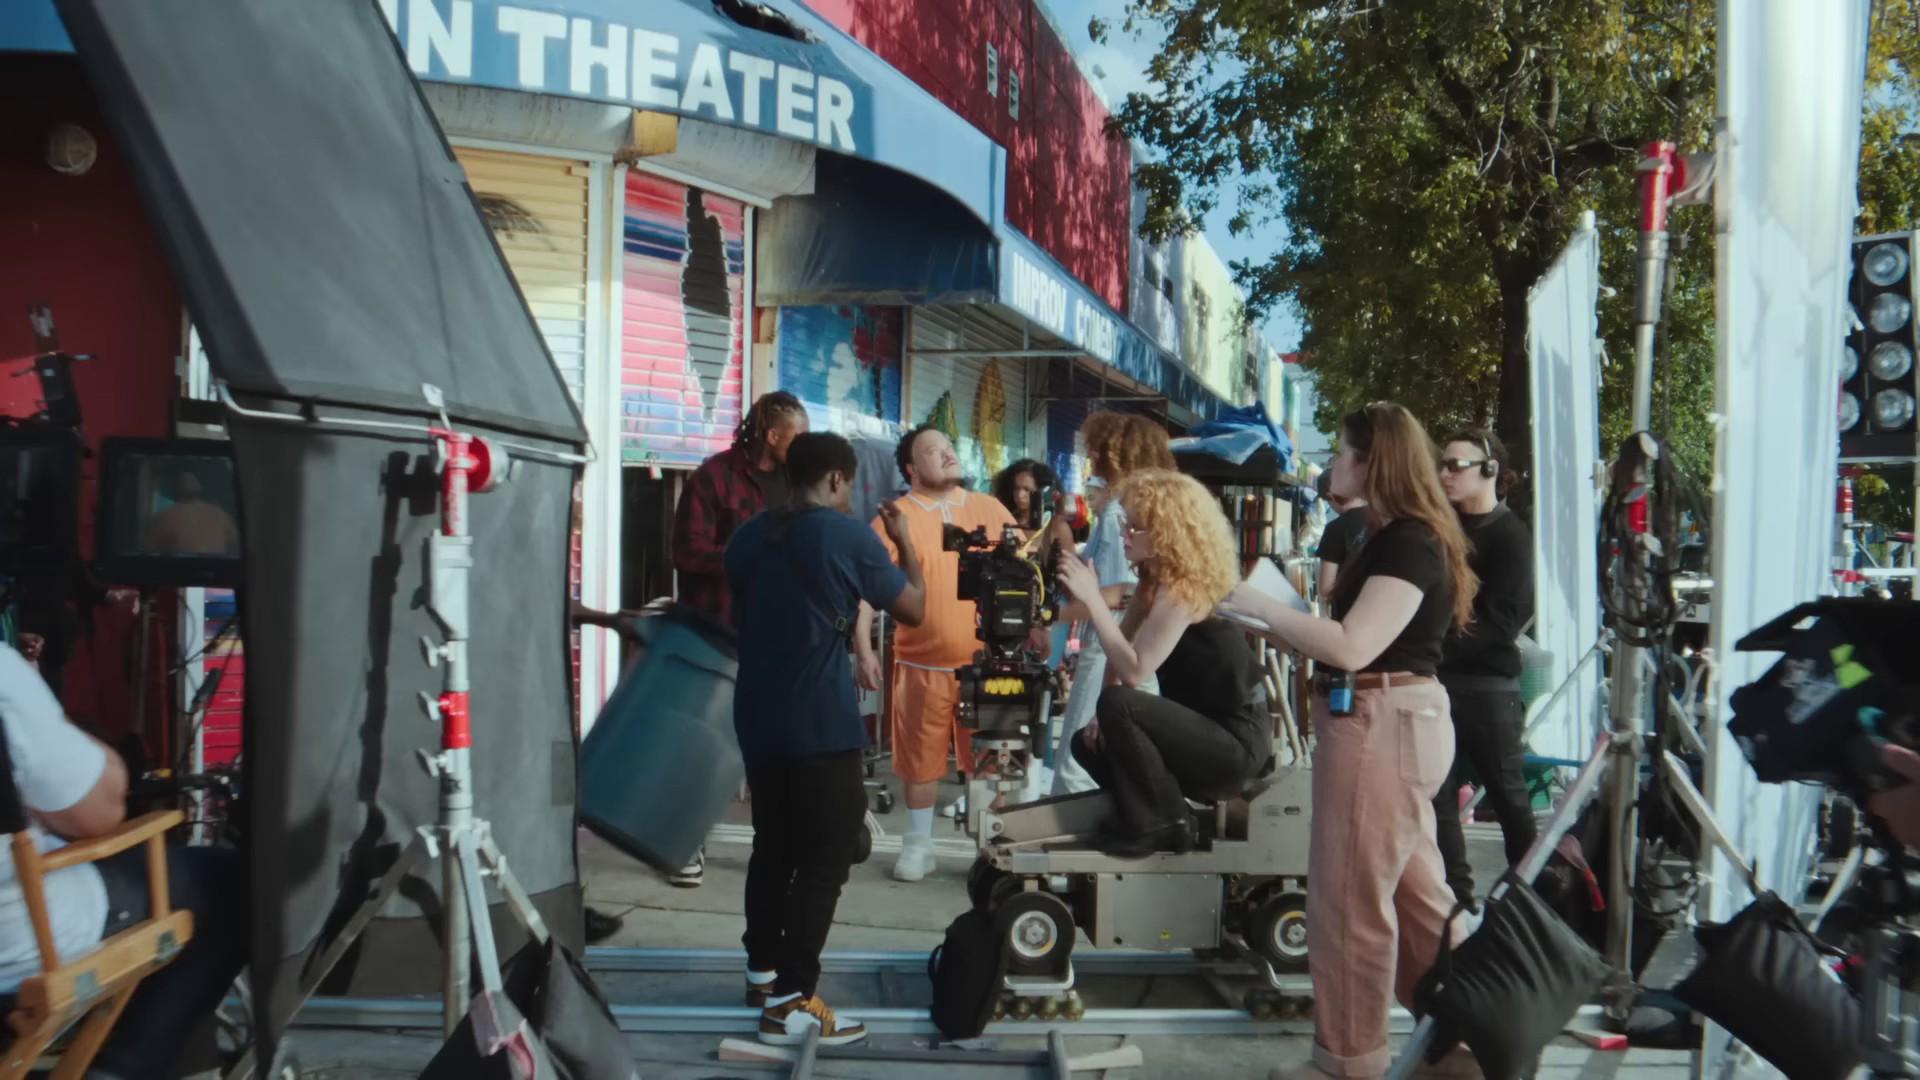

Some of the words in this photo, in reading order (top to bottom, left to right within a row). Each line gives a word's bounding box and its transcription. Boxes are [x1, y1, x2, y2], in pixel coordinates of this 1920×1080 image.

[378, 0, 473, 77] N
[498, 6, 856, 151] THEATER
[1012, 252, 1067, 332] IMPROV
